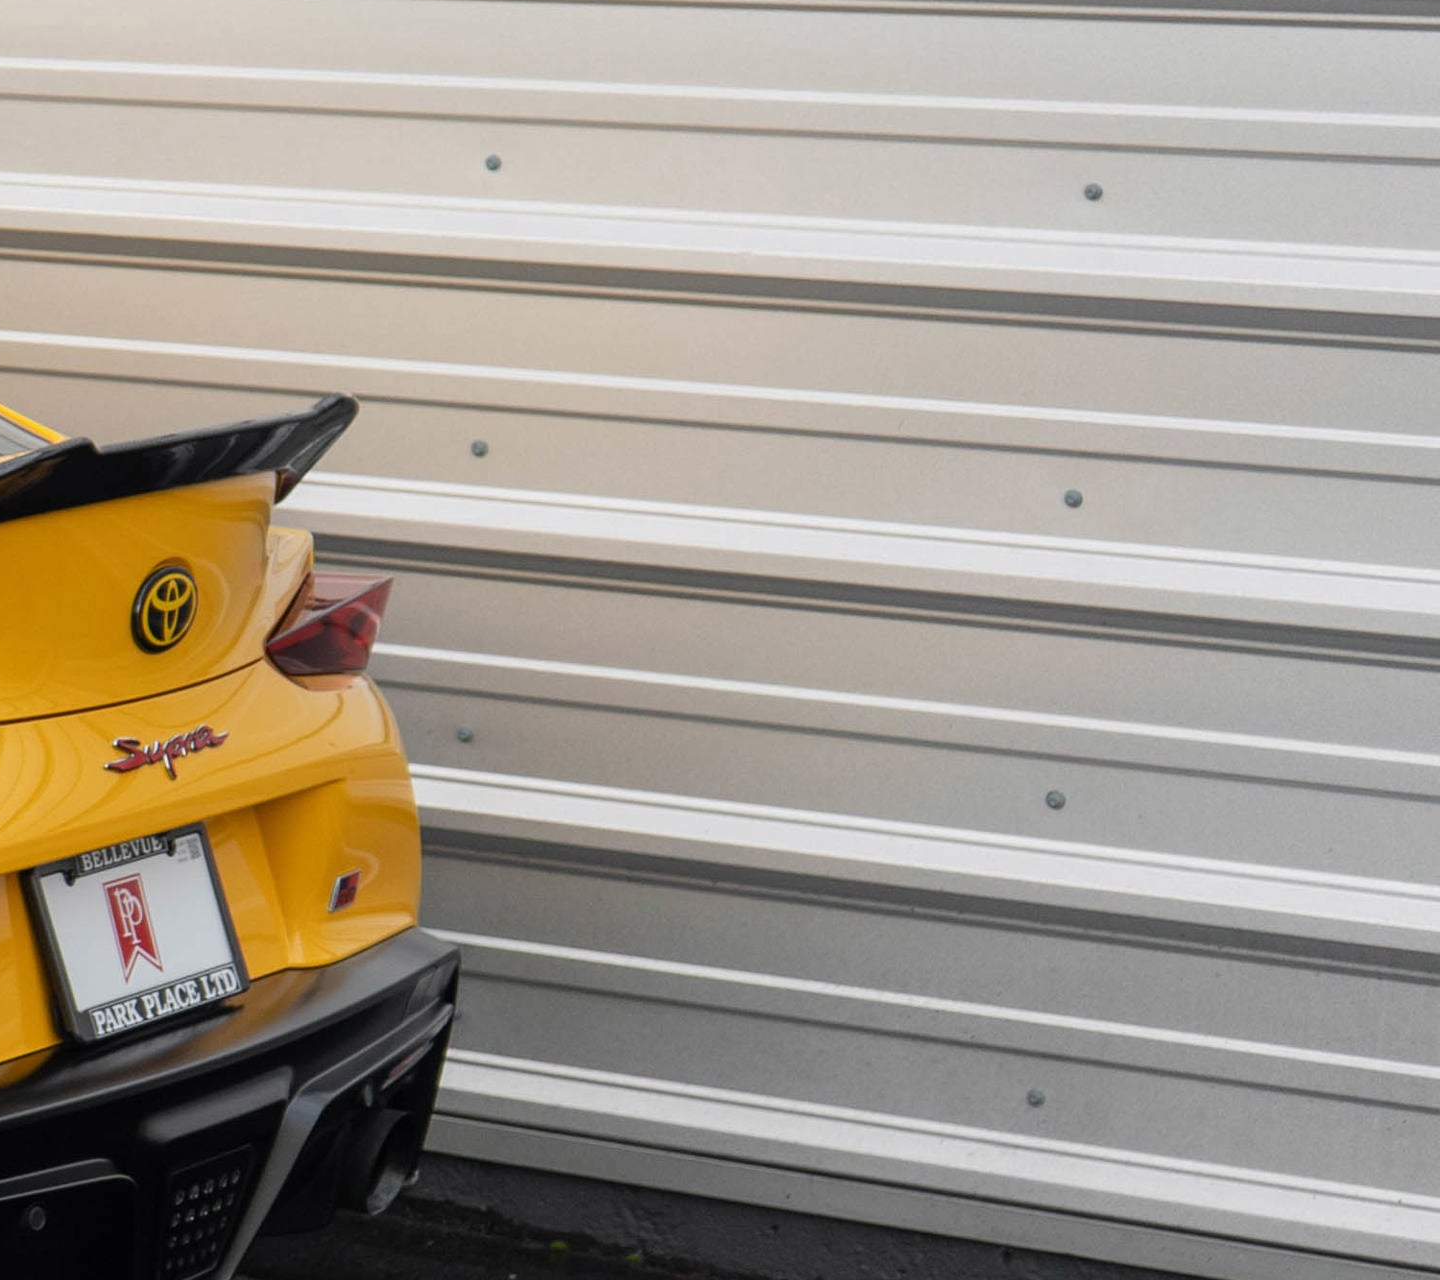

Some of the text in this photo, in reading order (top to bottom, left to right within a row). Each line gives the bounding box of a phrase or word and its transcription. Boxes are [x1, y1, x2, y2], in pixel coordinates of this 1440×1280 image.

[102, 723, 230, 781] Supra
[81, 835, 163, 871] BELLEVUE
[92, 968, 238, 1035] PARK PLACE LTD
